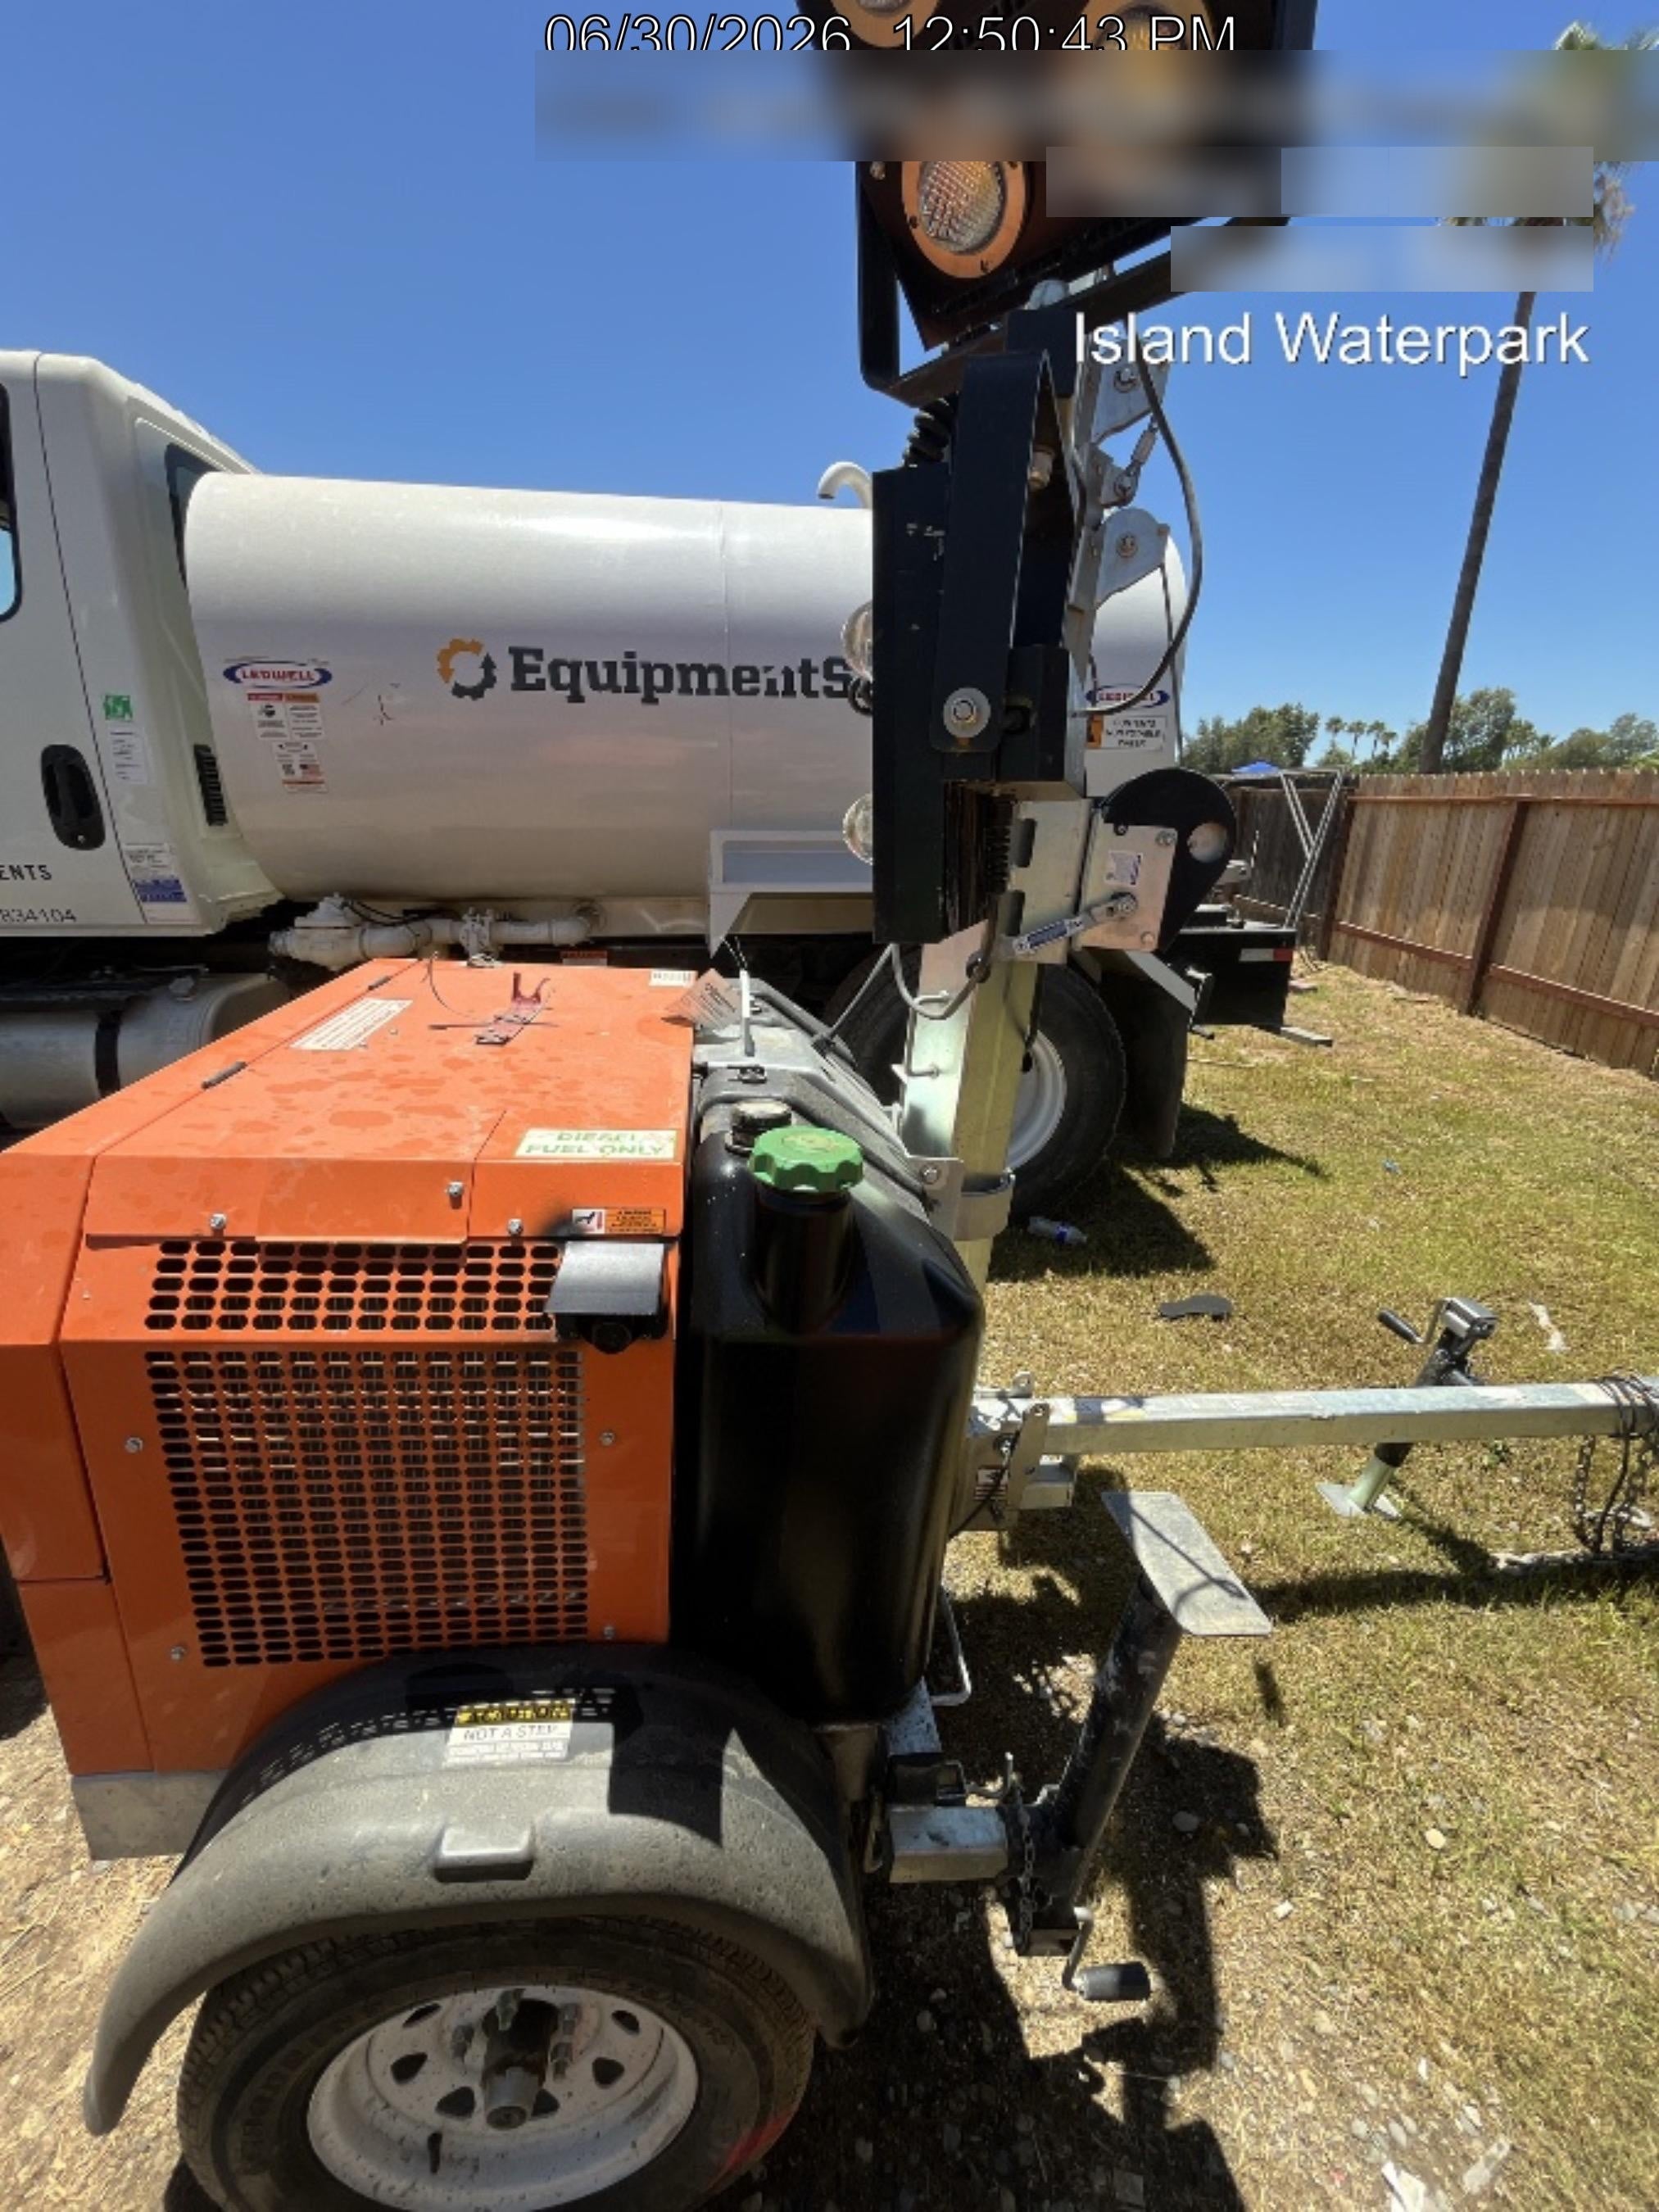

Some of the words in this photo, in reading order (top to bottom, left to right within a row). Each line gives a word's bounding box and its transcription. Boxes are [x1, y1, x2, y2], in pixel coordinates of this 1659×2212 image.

[0, 863, 52, 881] ENTS
[525, 1144, 590, 1154] FUEL
[599, 1144, 664, 1155] ONLY
[464, 1728, 499, 1741] NOT
[515, 1725, 559, 1738] STEP
